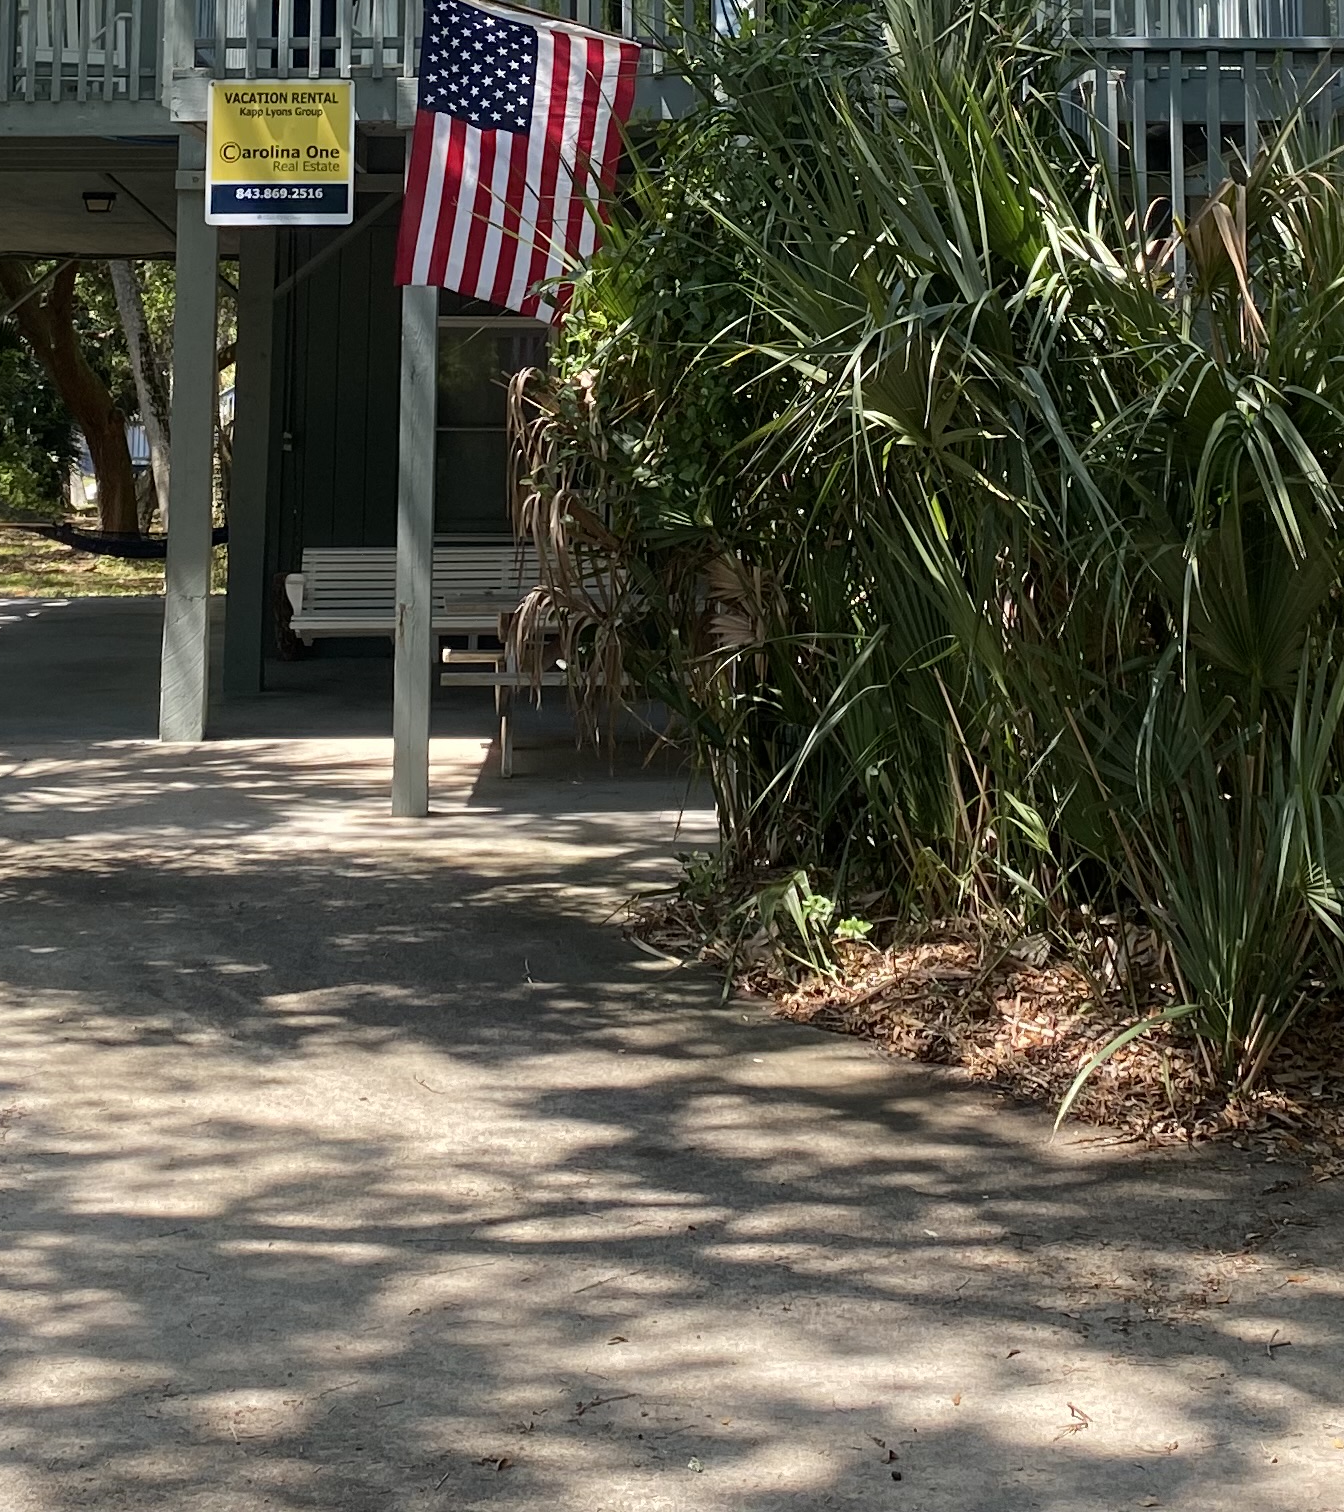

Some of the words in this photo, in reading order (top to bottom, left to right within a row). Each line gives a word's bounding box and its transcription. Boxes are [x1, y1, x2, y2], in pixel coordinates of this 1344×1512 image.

[224, 92, 288, 104] VACATION
[291, 92, 339, 104] RENTAL
[239, 107, 263, 118] Kapp
[265, 107, 293, 118] Lyons
[295, 107, 323, 118] Group
[306, 145, 340, 159] One
[273, 161, 299, 172] Real
[302, 161, 340, 172] Estate
[235, 188, 324, 199] 843.869.2516
